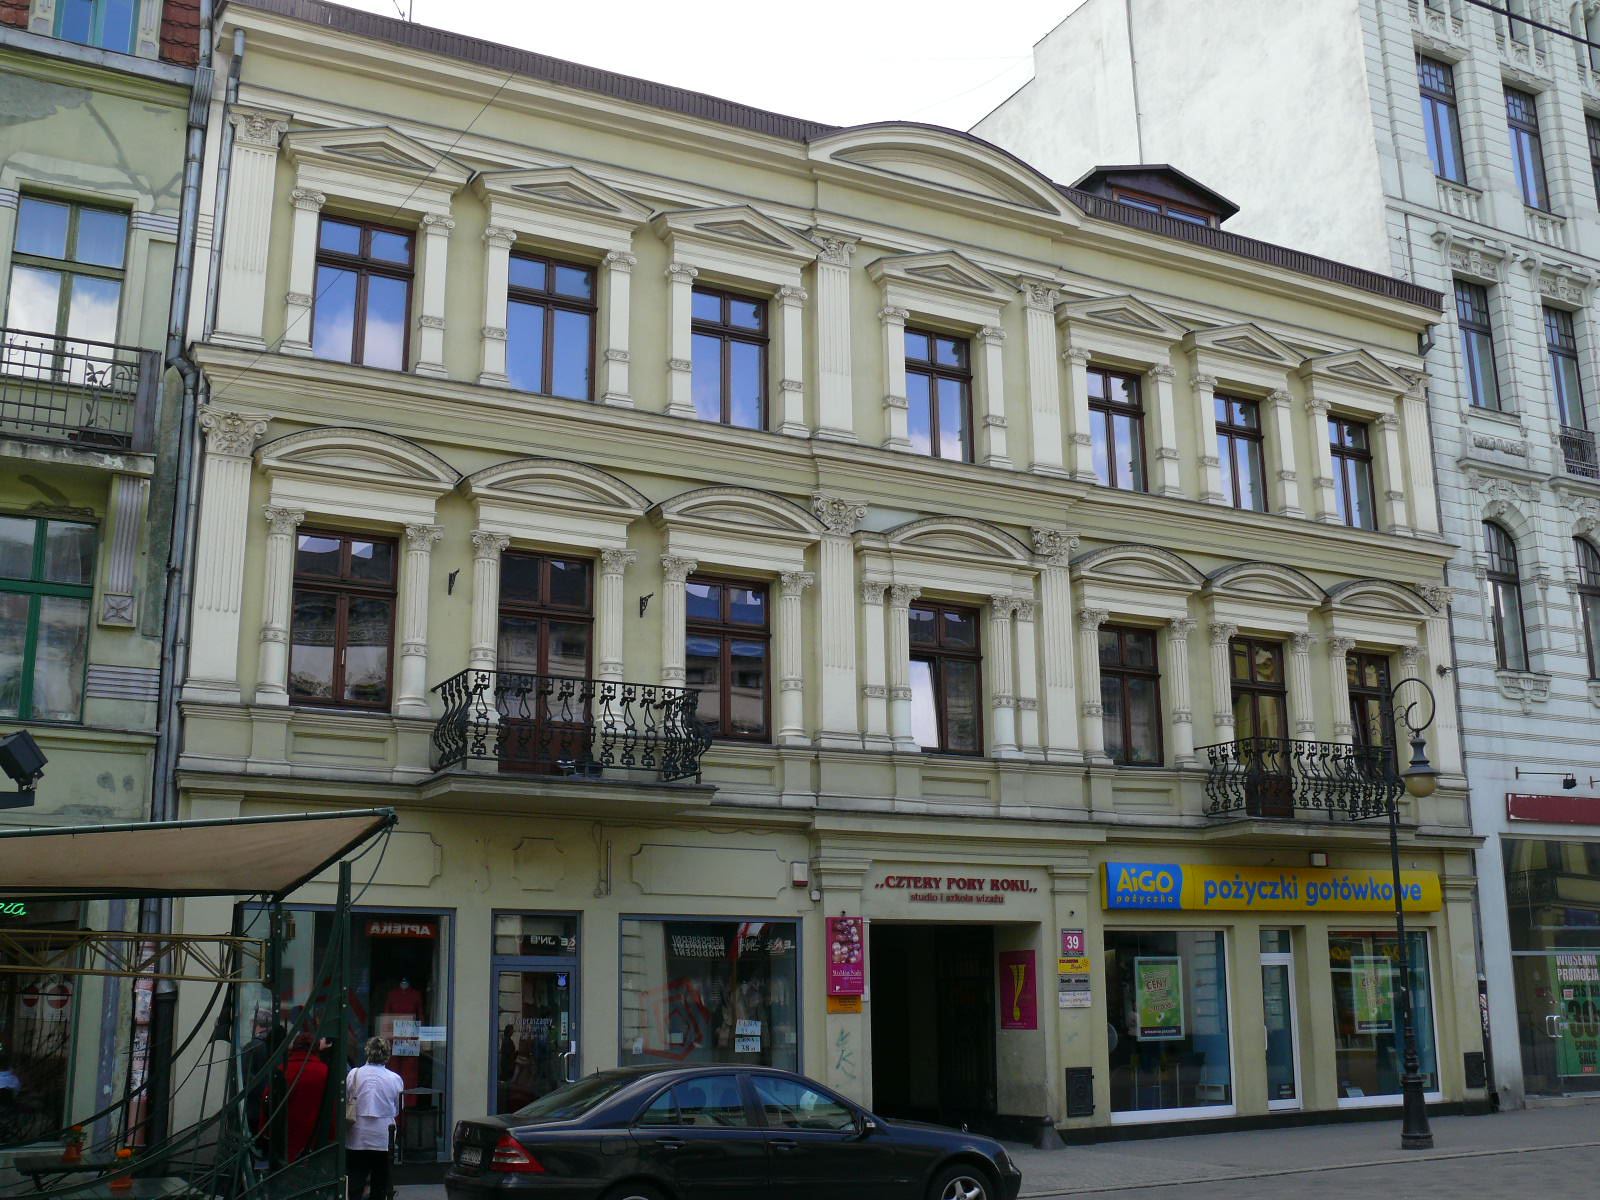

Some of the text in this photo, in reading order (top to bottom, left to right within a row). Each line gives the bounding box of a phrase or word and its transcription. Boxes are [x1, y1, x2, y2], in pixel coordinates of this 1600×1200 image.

[947, 878, 985, 890] PORY
[1204, 872, 1422, 906] pożyczki gotówkowe
[911, 893, 938, 902] studio
[1116, 894, 1175, 904] pożyczka
[1066, 935, 1079, 949] 39
[1556, 955, 1597, 966] WIOSENNA
[1557, 968, 1600, 981] PROMOCJA
